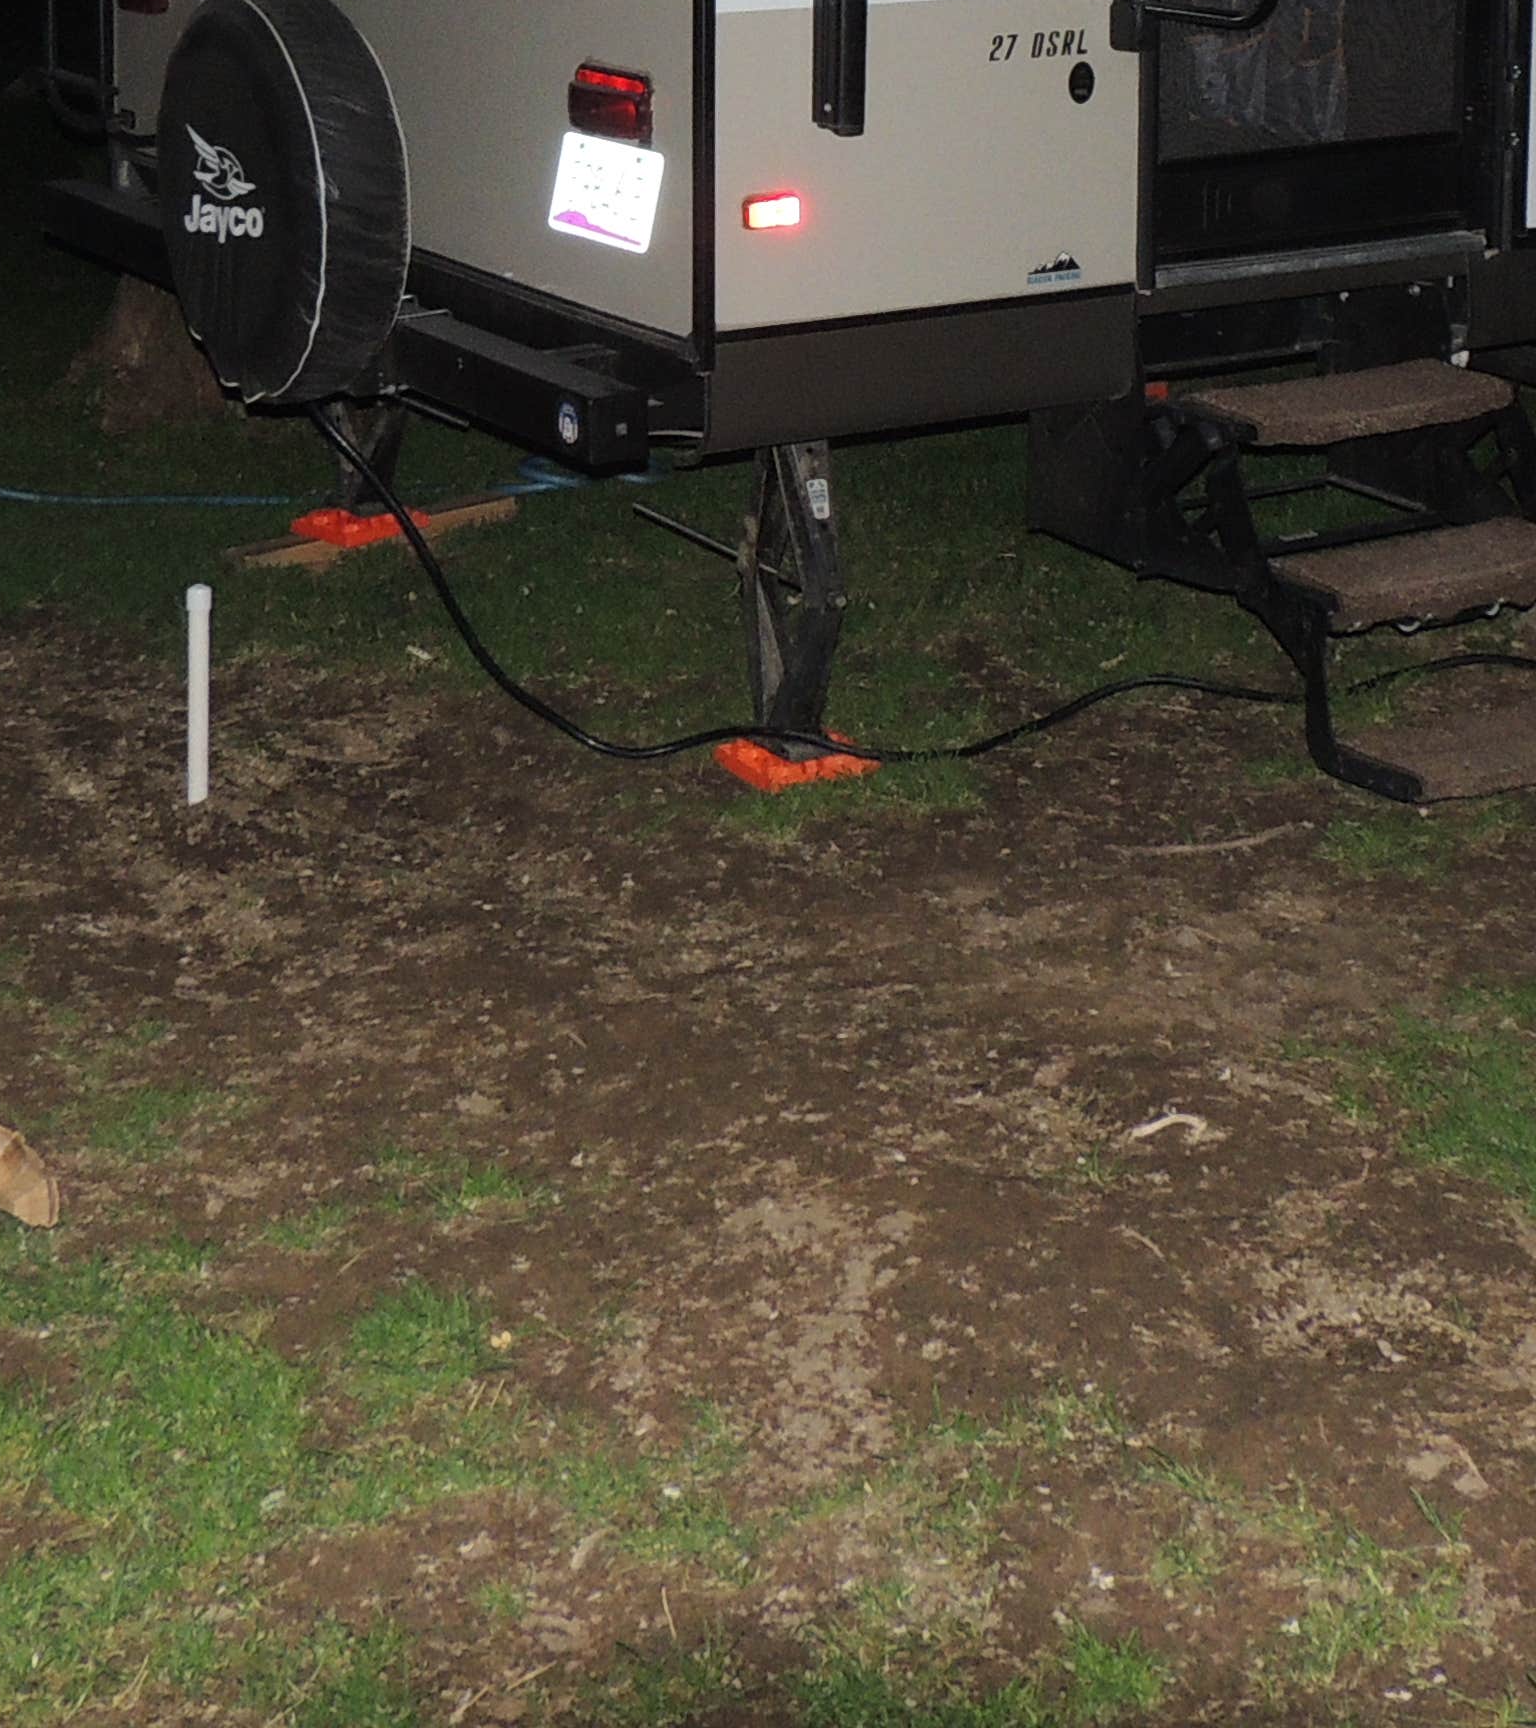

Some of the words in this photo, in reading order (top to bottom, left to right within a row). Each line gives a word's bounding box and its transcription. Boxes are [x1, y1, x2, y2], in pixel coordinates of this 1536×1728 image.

[989, 34, 1019, 62] 27
[1031, 29, 1089, 59] DSRL
[184, 194, 264, 244] Jayco
